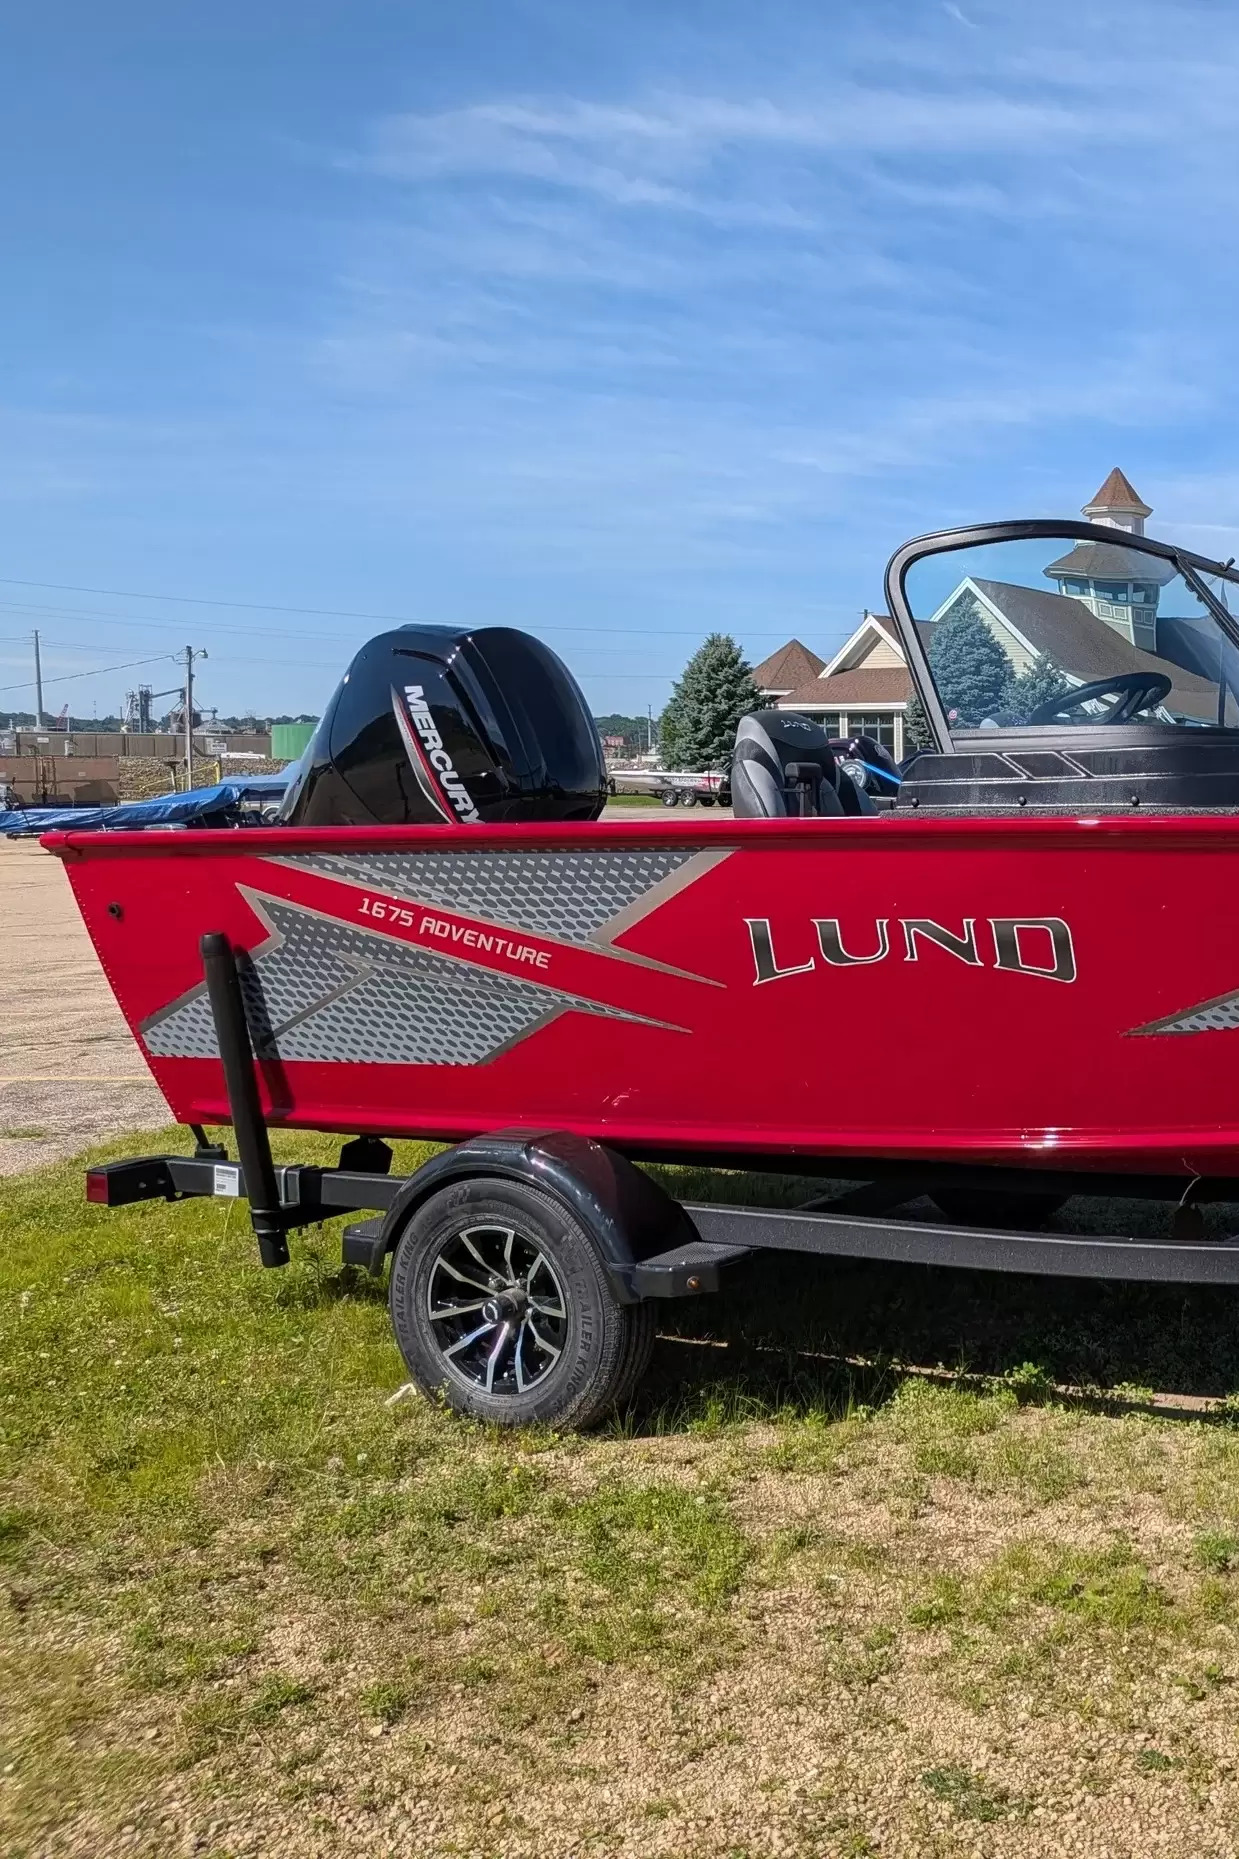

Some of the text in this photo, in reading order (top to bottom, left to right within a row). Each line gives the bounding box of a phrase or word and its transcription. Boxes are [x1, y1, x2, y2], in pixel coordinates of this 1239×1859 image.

[404, 685, 486, 824] MERCURY
[358, 897, 552, 969] 1675 ADVENTURE
[742, 917, 1077, 986] LUND
